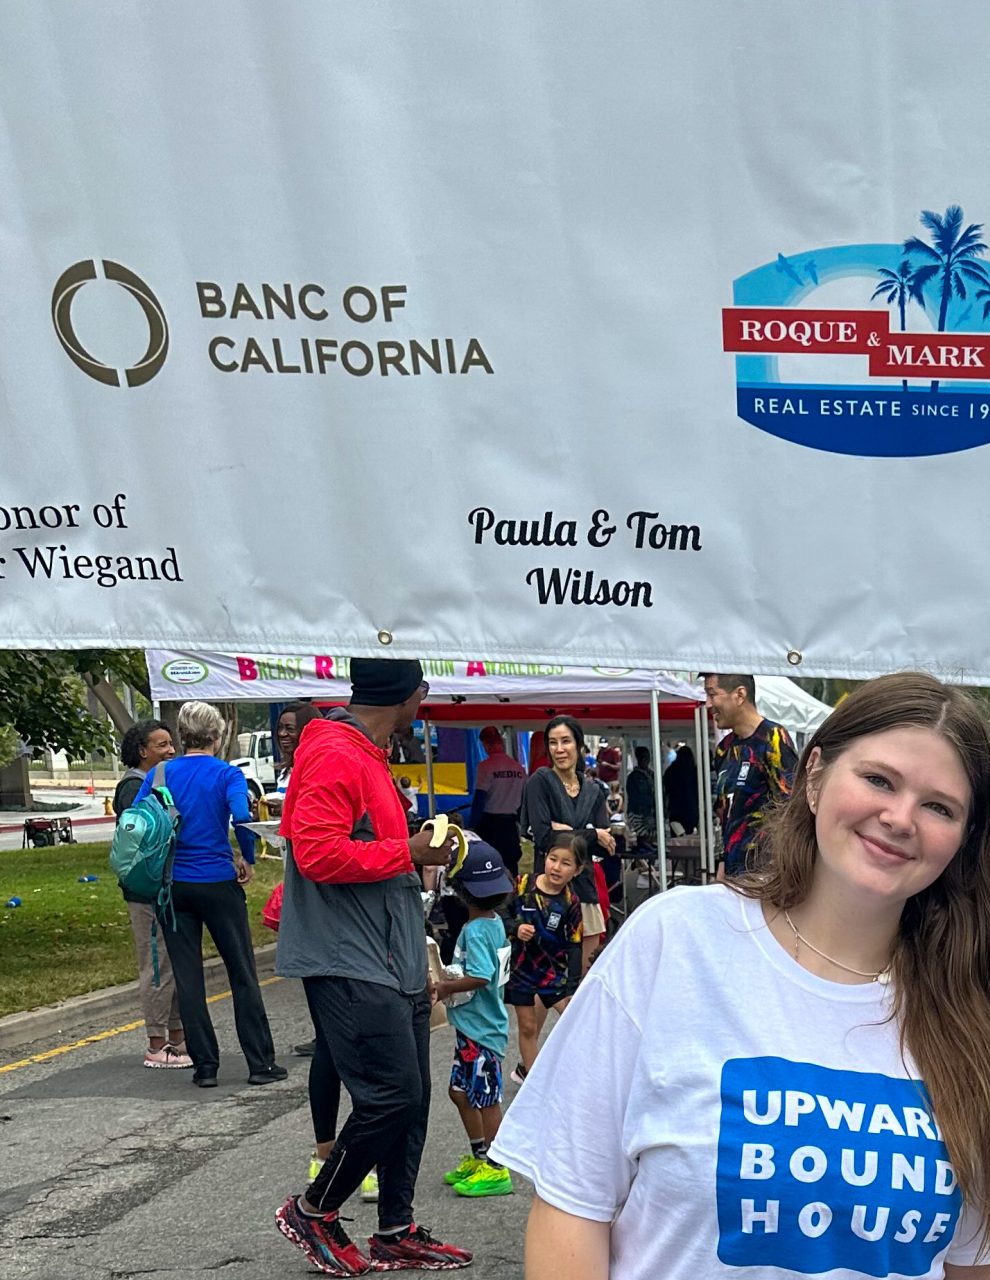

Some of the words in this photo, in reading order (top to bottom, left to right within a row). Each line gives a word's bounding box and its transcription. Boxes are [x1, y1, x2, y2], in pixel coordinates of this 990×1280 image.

[196, 281, 329, 321] BANC
[342, 285, 408, 323] OF
[208, 337, 494, 377] CALIFORNIA
[740, 320, 857, 346] ROQUE
[867, 332, 881, 347] &
[886, 344, 984, 368] MARK
[754, 398, 808, 415] REAL
[820, 400, 901, 417] ESTATE
[912, 405, 959, 417] SINCE
[93, 493, 128, 529] of
[468, 507, 578, 547] Paula
[587, 509, 617, 547] &
[626, 511, 702, 551] Tom
[12, 544, 184, 588] Wiegand
[526, 567, 654, 607] Wilson
[236, 656, 304, 681] BREAST
[493, 770, 523, 779] MEDIC
[742, 1088, 943, 1142] UPWAR
[740, 1143, 957, 1196] BOUND
[741, 1198, 951, 1243] HOUSE
